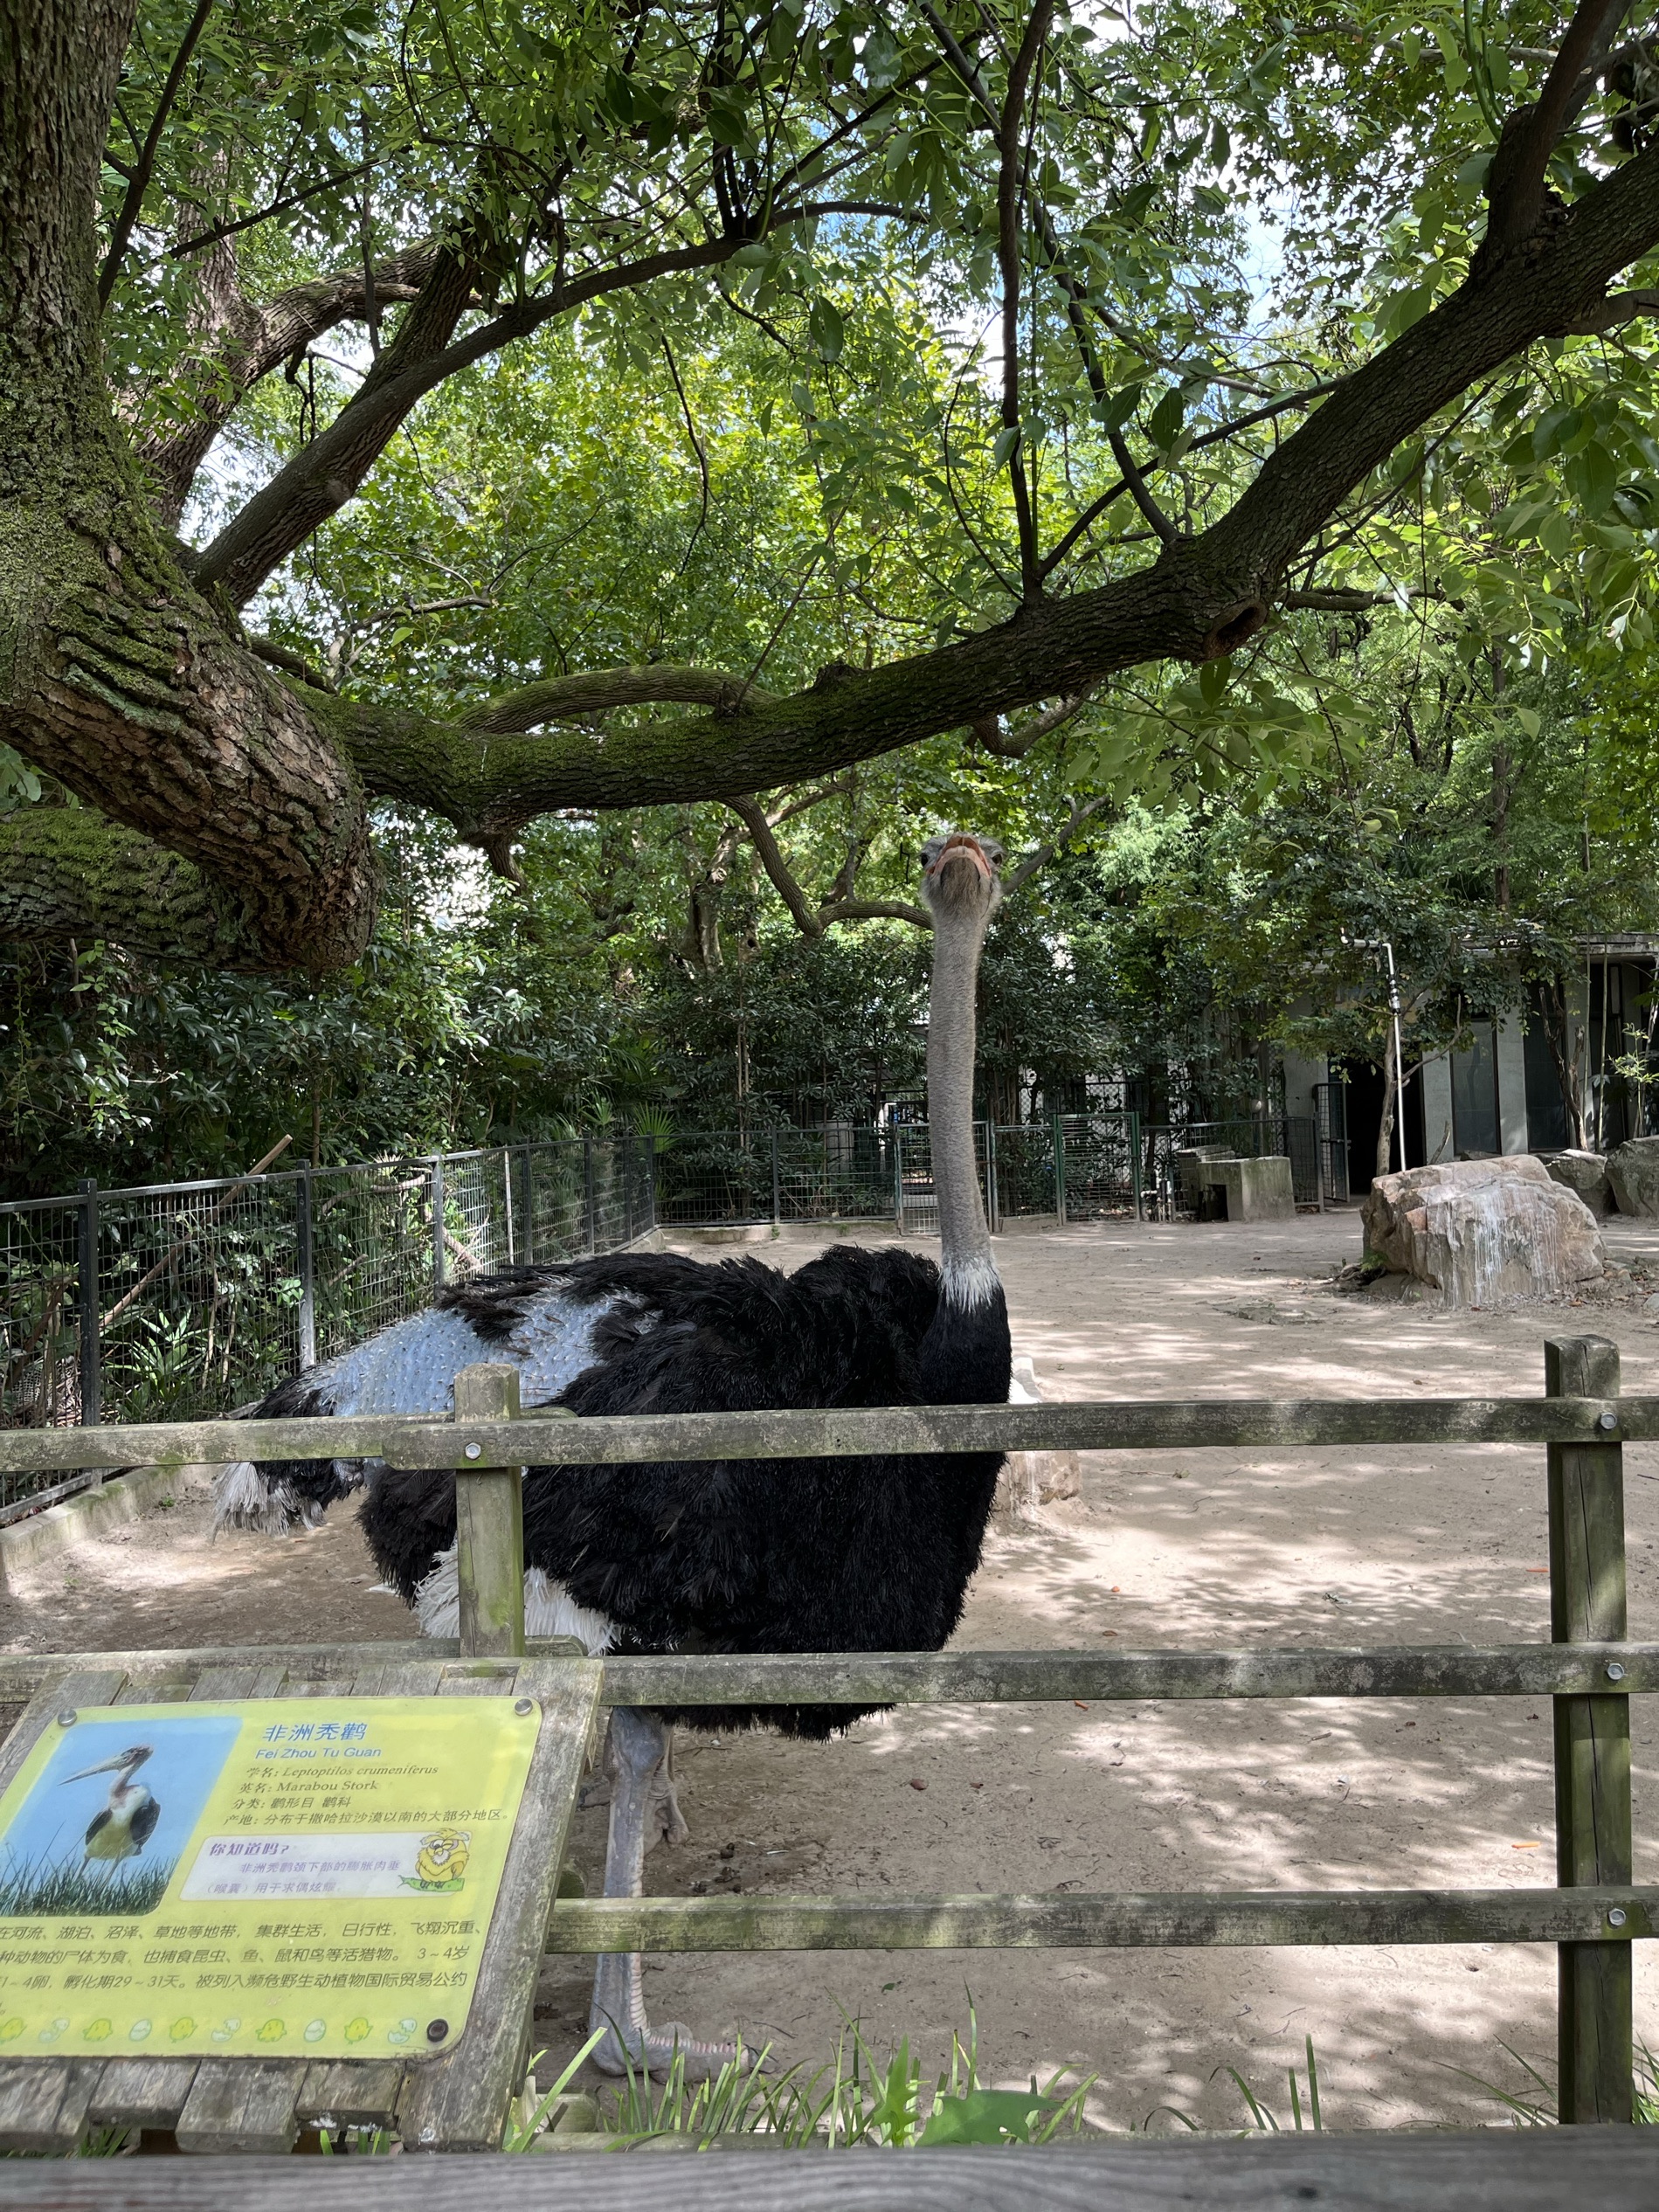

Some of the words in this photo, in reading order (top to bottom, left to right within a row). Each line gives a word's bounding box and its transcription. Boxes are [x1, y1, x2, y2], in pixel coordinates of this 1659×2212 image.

[262, 1722, 367, 1743] 非洲秃鹳
[255, 1749, 278, 1759] Fei
[280, 1748, 316, 1759] Zhou
[322, 1748, 339, 1759] Tu
[344, 1747, 382, 1758] Guan
[282, 1766, 352, 1779] Leptoptilos
[357, 1765, 439, 1776] crumeniferus
[277, 1782, 337, 1792] Marabou
[342, 1780, 379, 1790] Stork
